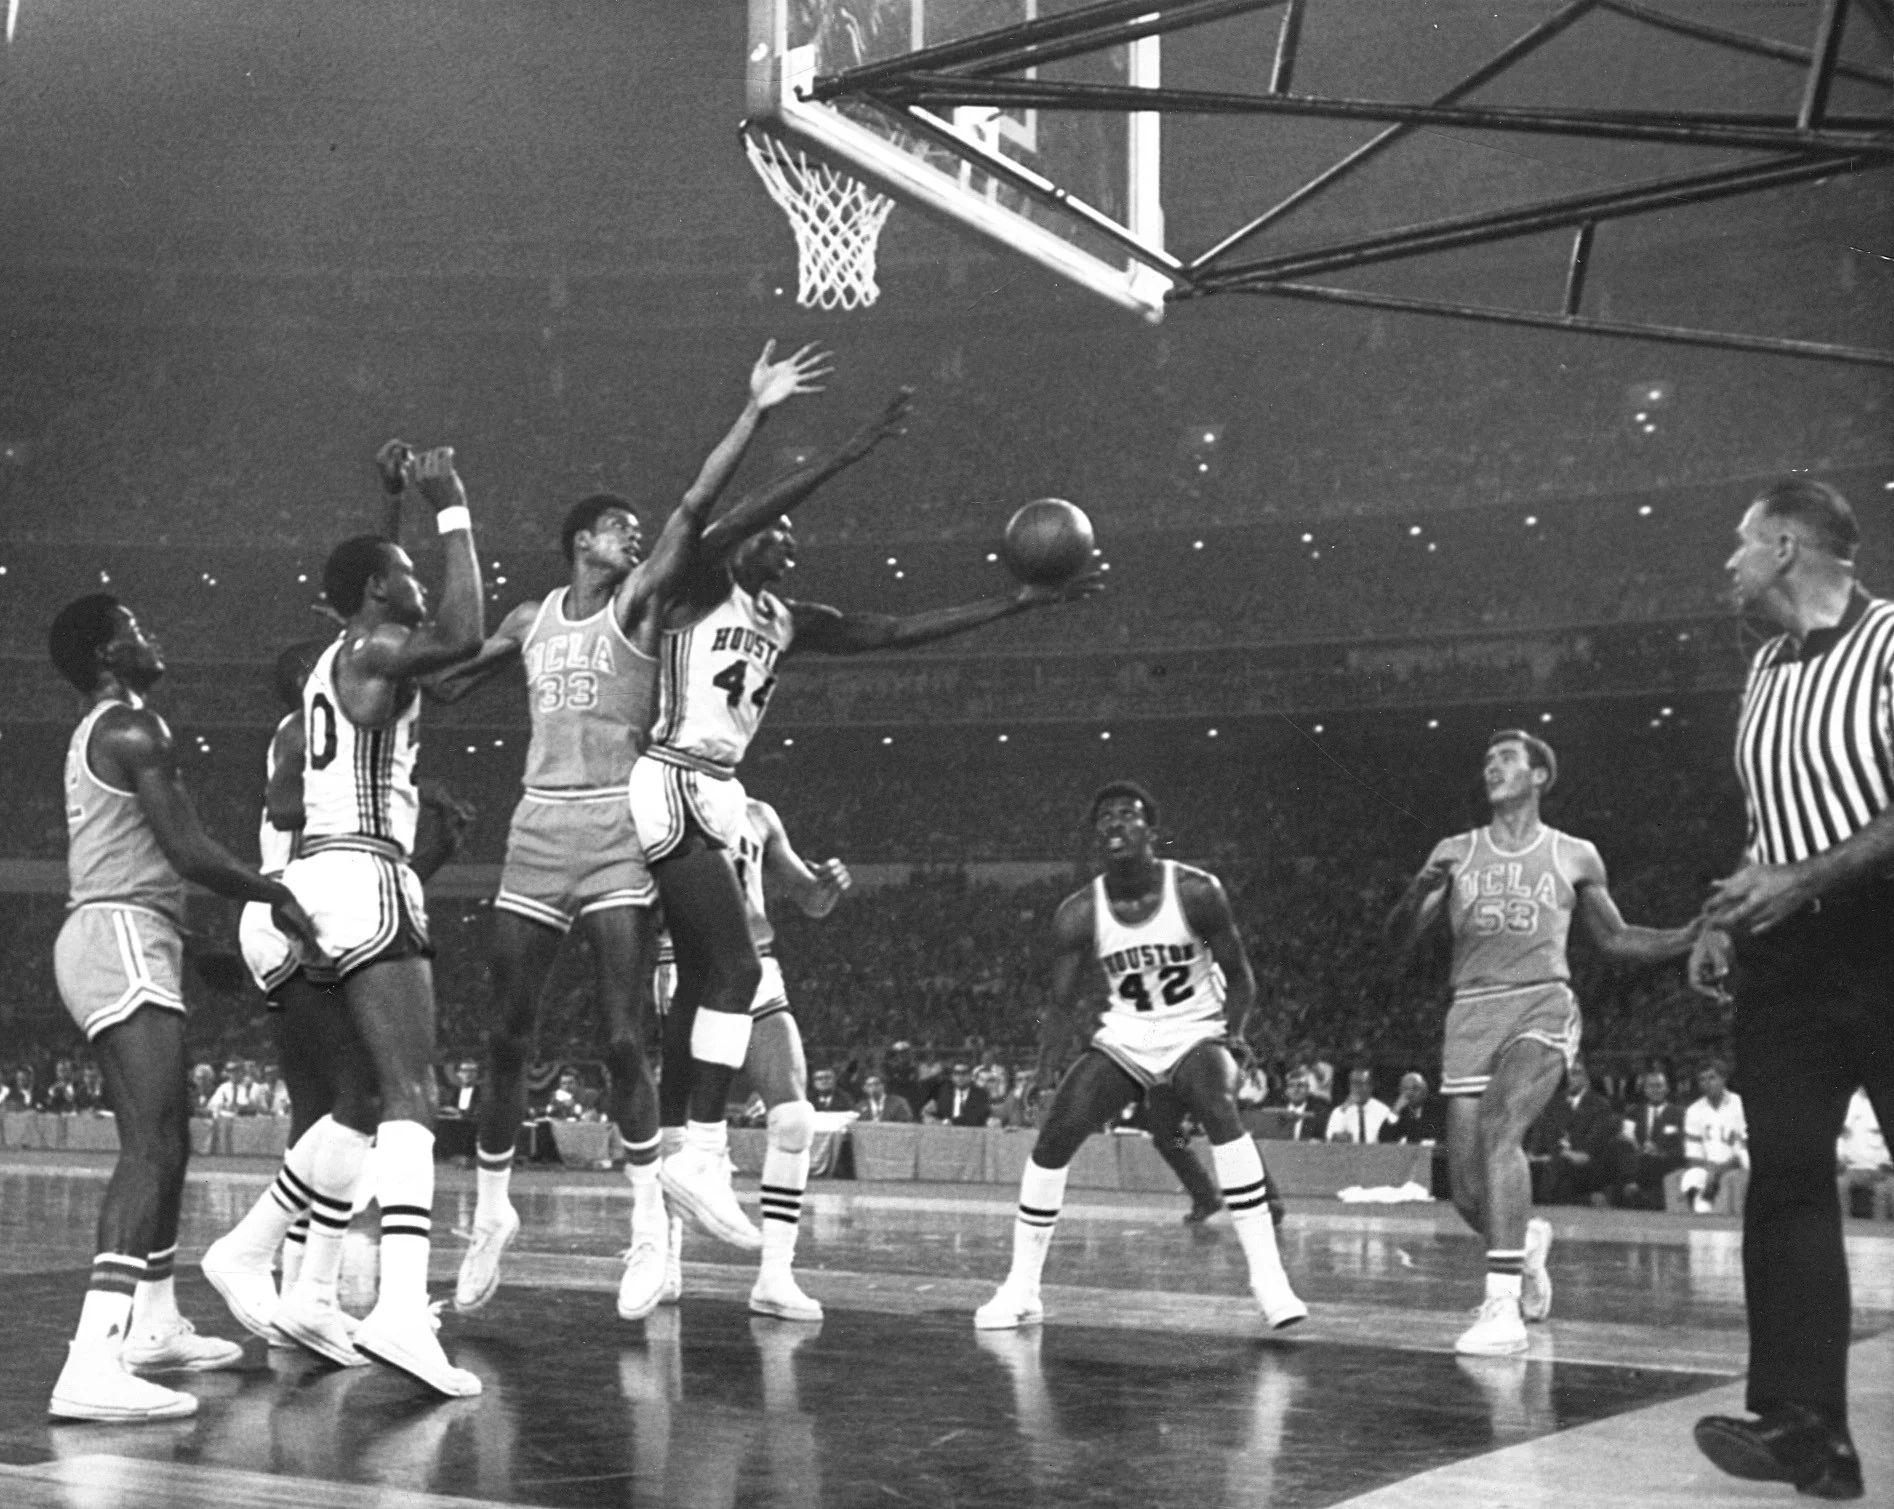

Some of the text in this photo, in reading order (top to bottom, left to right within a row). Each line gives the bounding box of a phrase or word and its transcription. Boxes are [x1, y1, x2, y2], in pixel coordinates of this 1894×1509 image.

[537, 671, 599, 713] 33
[1460, 862, 1558, 911] UCLA
[1475, 898, 1540, 936] 53
[1118, 965, 1195, 1011] 42
